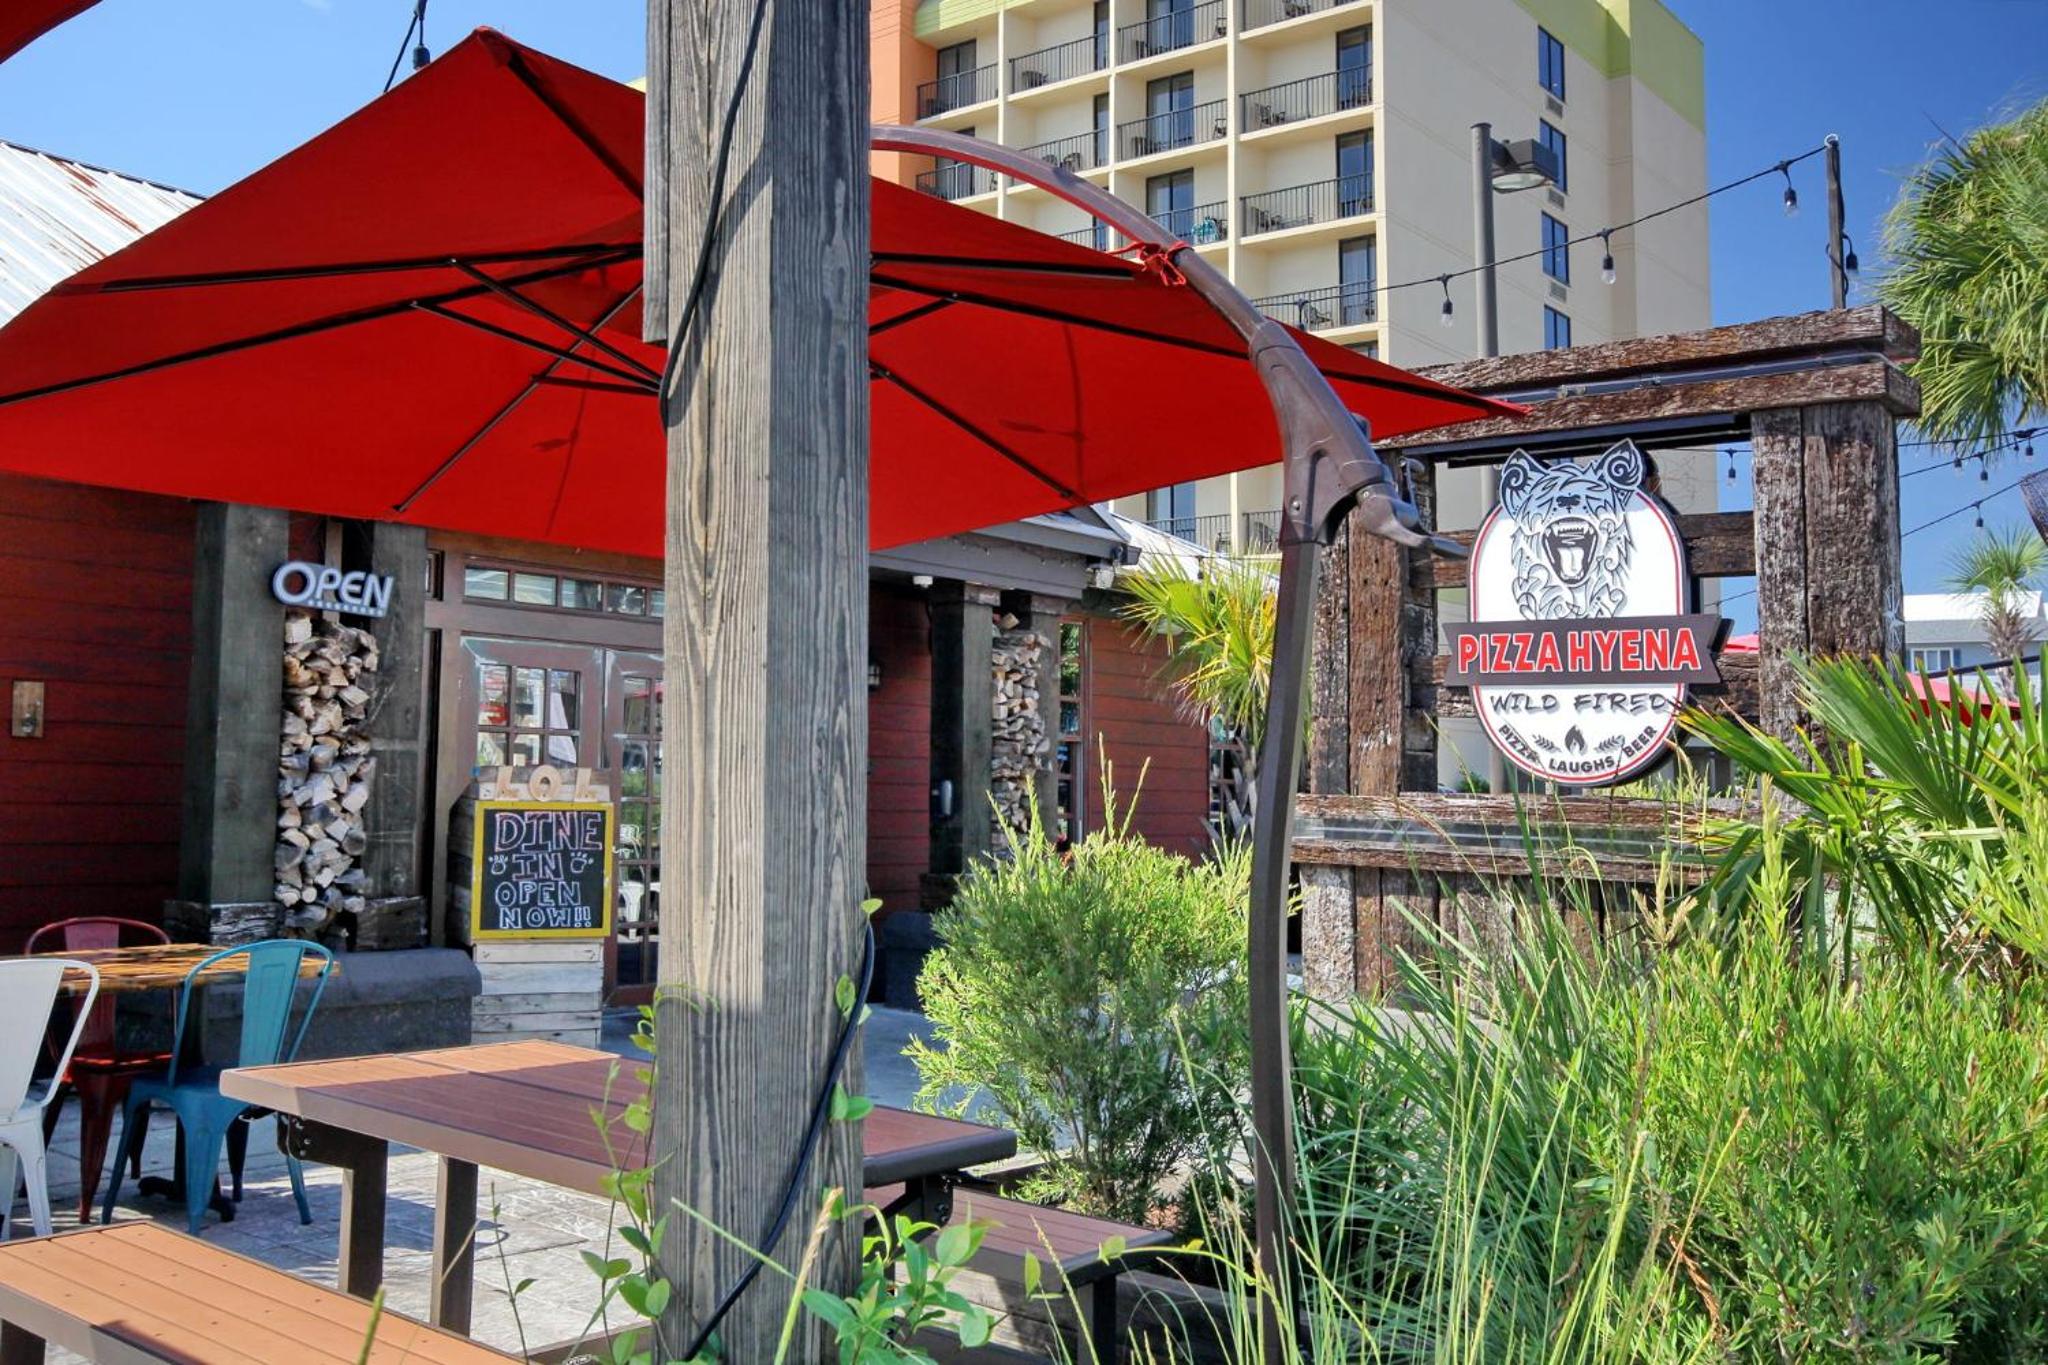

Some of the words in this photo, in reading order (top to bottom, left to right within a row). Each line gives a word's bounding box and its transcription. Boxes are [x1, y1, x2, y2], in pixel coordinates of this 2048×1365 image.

[272, 561, 395, 610] OPEN
[1458, 632, 1562, 673] PIZZA
[1568, 627, 1701, 671] HYENA
[1490, 692, 1558, 713] WILD
[1573, 692, 1666, 713] FIRED
[1499, 724, 1540, 763] PIZZA
[1549, 755, 1615, 773] LAUGHS
[1622, 725, 1658, 758] BEER
[495, 812, 603, 853] DINE
[512, 853, 565, 881] IN
[495, 880, 581, 907] OPEN
[500, 906, 592, 929] NOW!!
